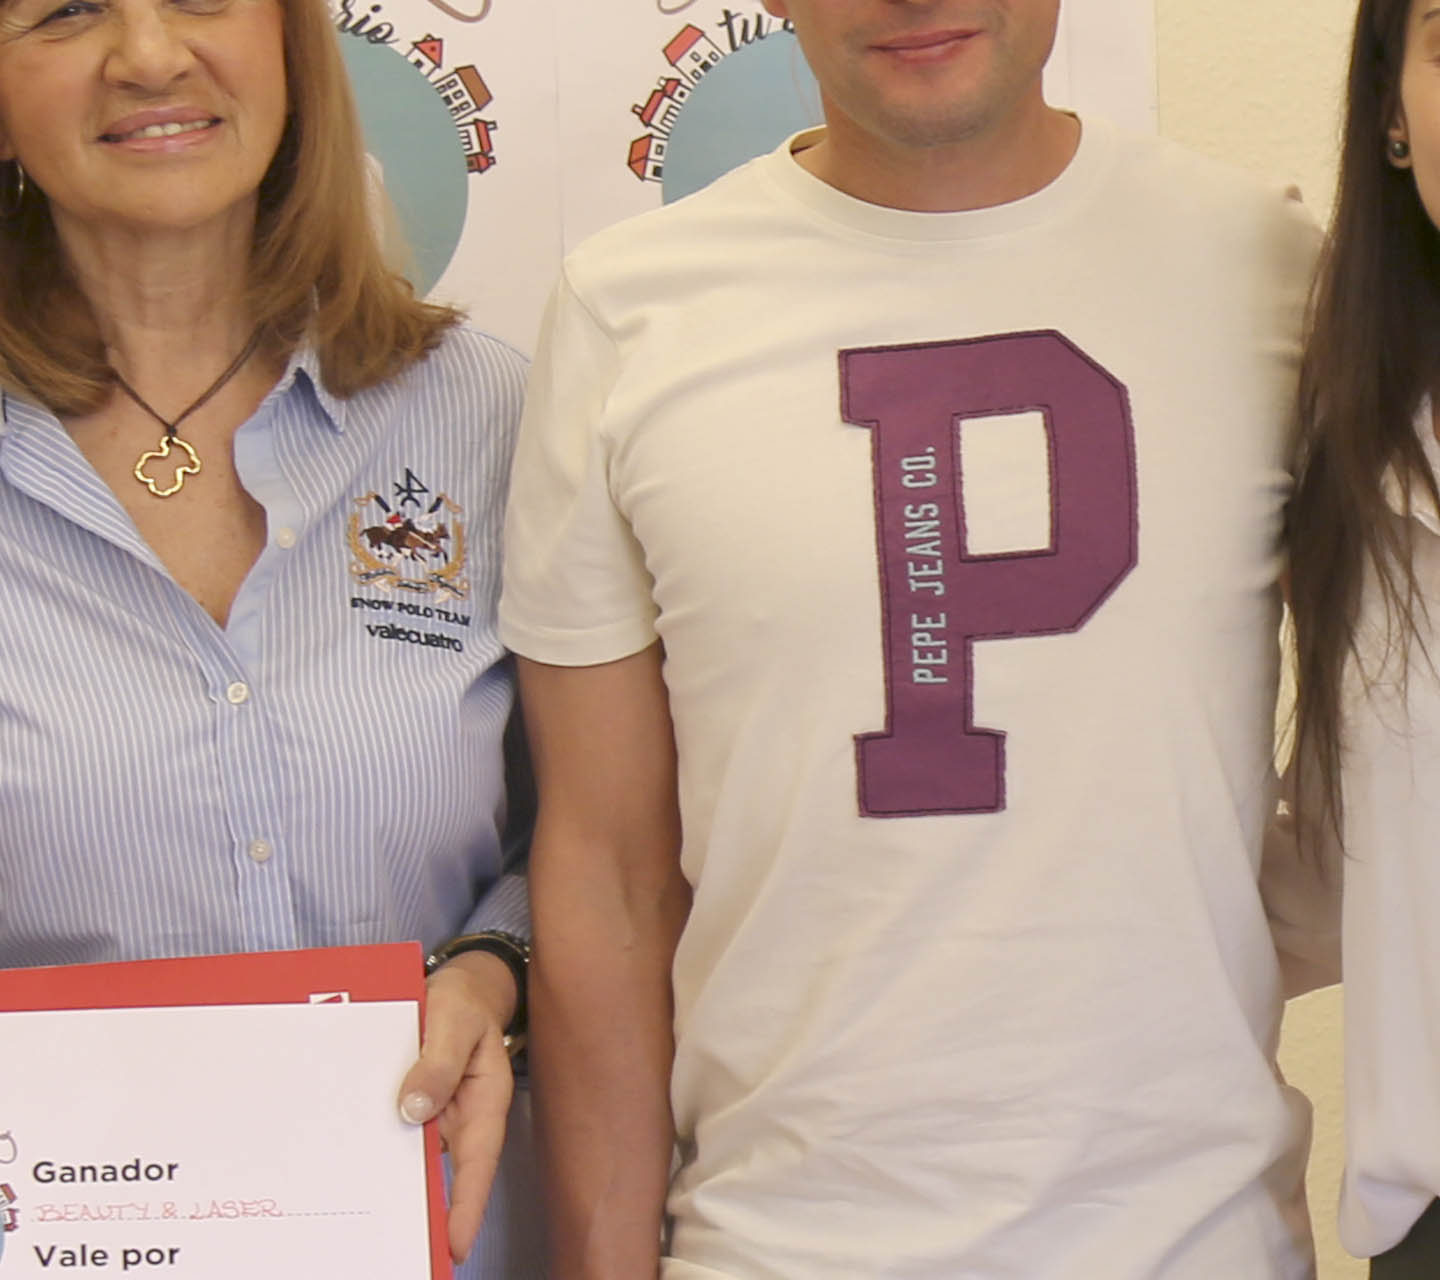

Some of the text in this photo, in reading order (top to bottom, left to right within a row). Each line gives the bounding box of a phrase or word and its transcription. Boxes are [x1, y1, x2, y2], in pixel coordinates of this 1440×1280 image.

[837, 328, 1140, 818] P
[901, 446, 949, 684] PEPE JEANS CO.
[351, 597, 472, 627] SNOW POLO TEAM
[366, 623, 463, 653] valecuatro
[33, 1158, 180, 1184] Ganador
[160, 1200, 178, 1220] &
[189, 1198, 284, 1221] LASER
[33, 1244, 181, 1271] Vale por
